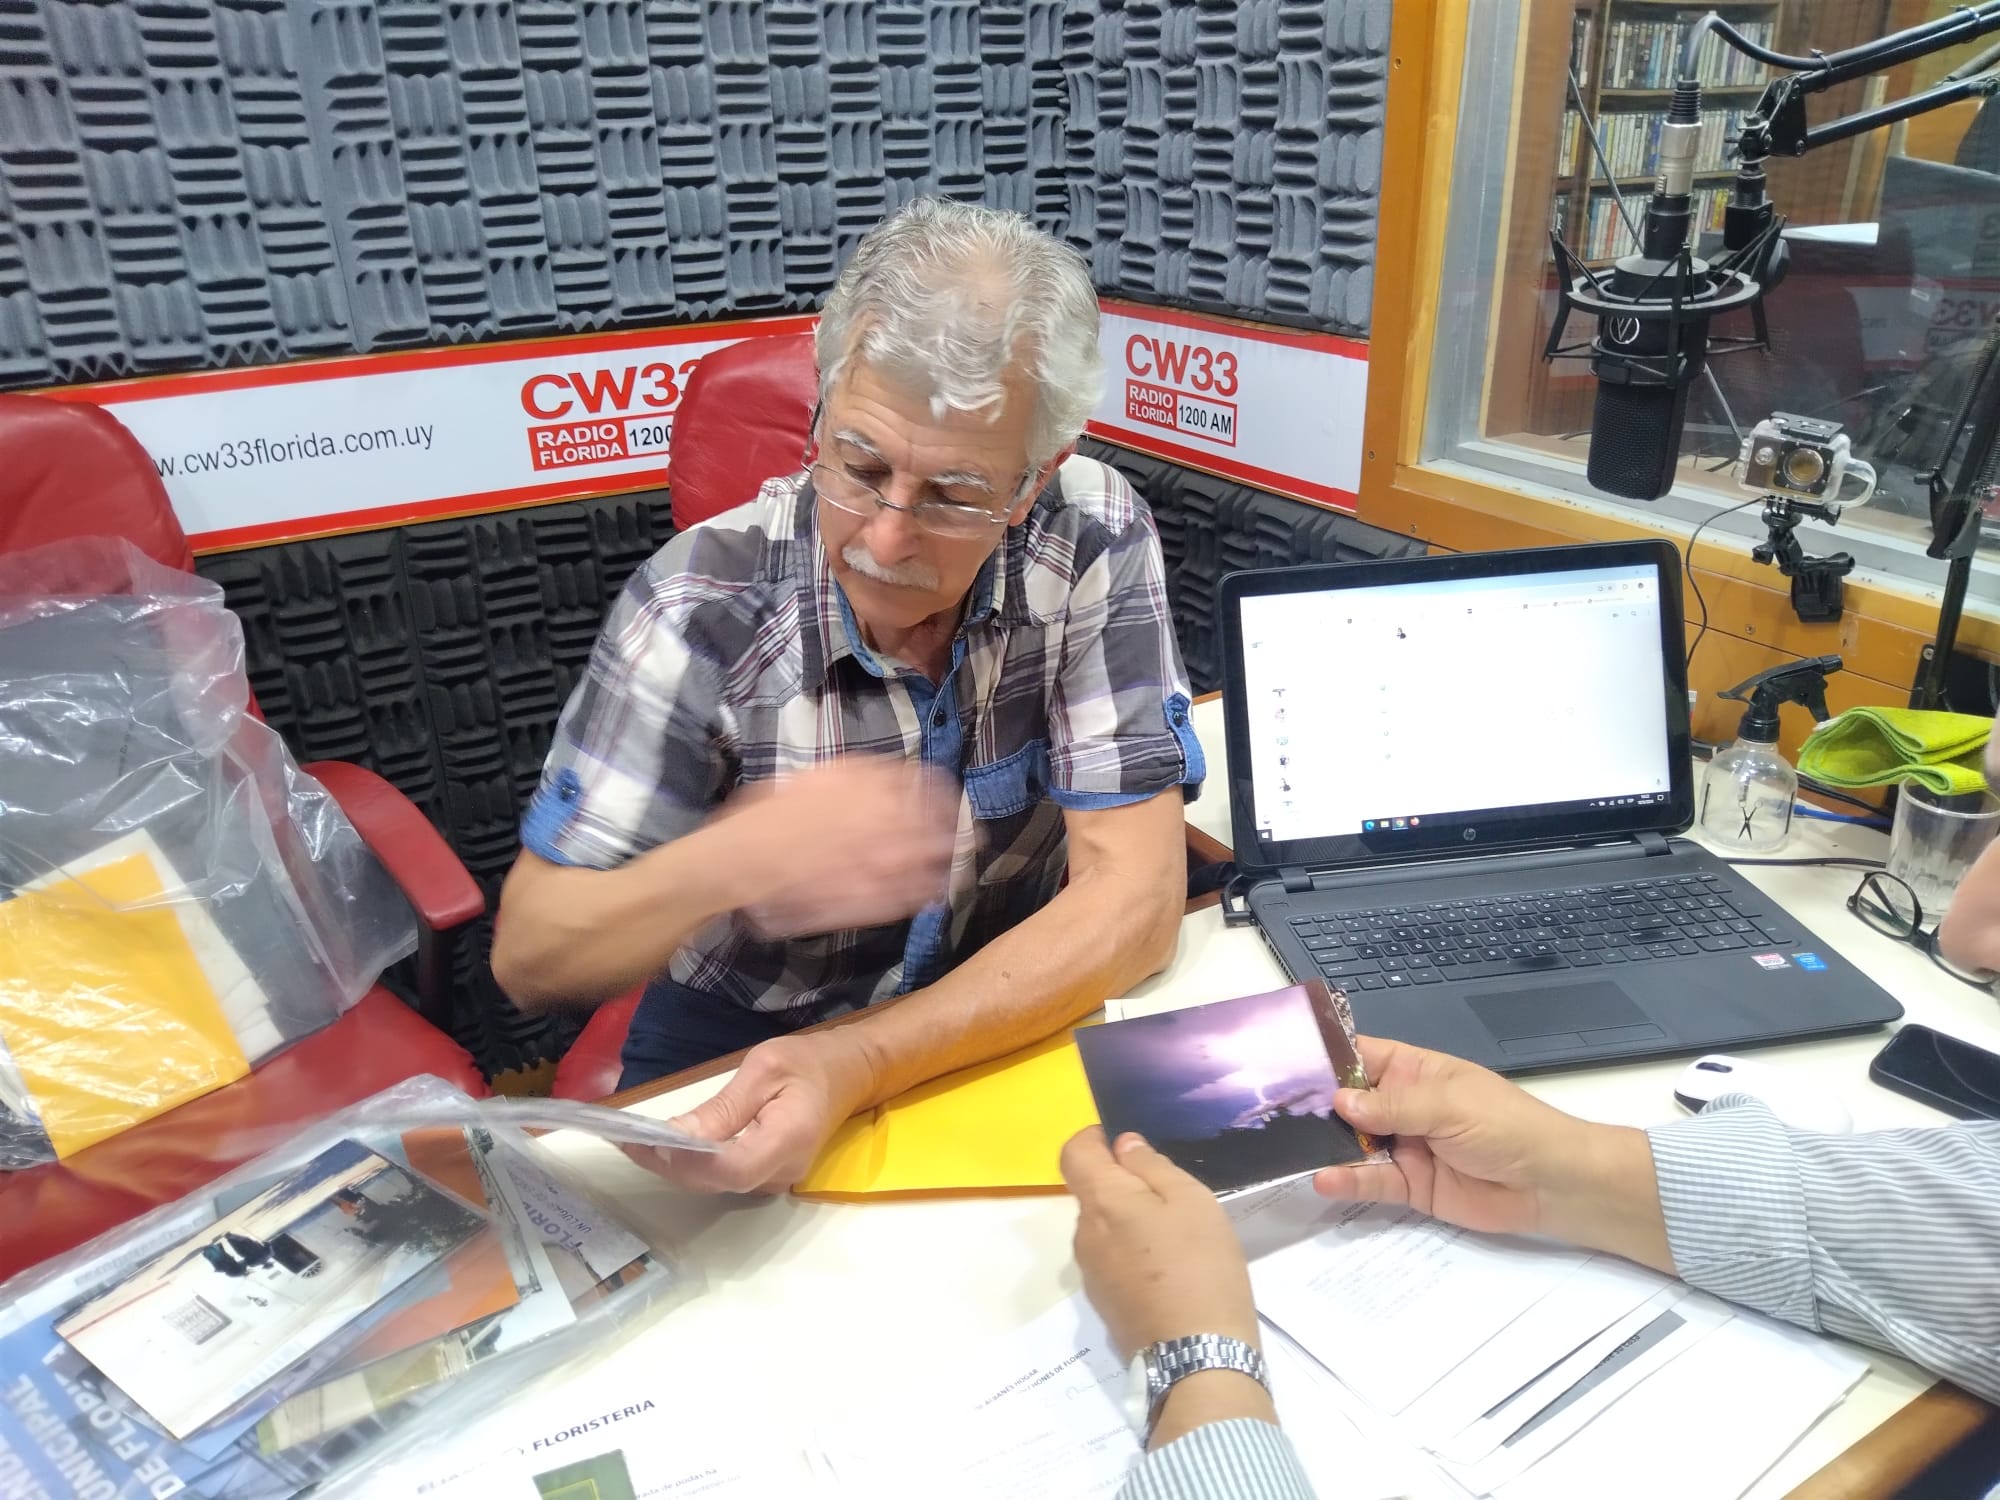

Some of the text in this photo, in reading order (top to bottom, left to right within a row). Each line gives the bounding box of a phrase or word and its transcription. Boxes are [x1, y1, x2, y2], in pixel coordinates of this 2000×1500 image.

[1125, 334, 1238, 397] CW33
[1129, 385, 1174, 409] RADIO
[1129, 403, 1175, 426] FLORIDA
[1179, 404, 1232, 435] 1200 AM
[536, 424, 618, 448] RADIO
[540, 443, 624, 465] FLORIDA
[532, 1400, 656, 1452] FLORISTERIA
[133, 1455, 187, 1500] DE
